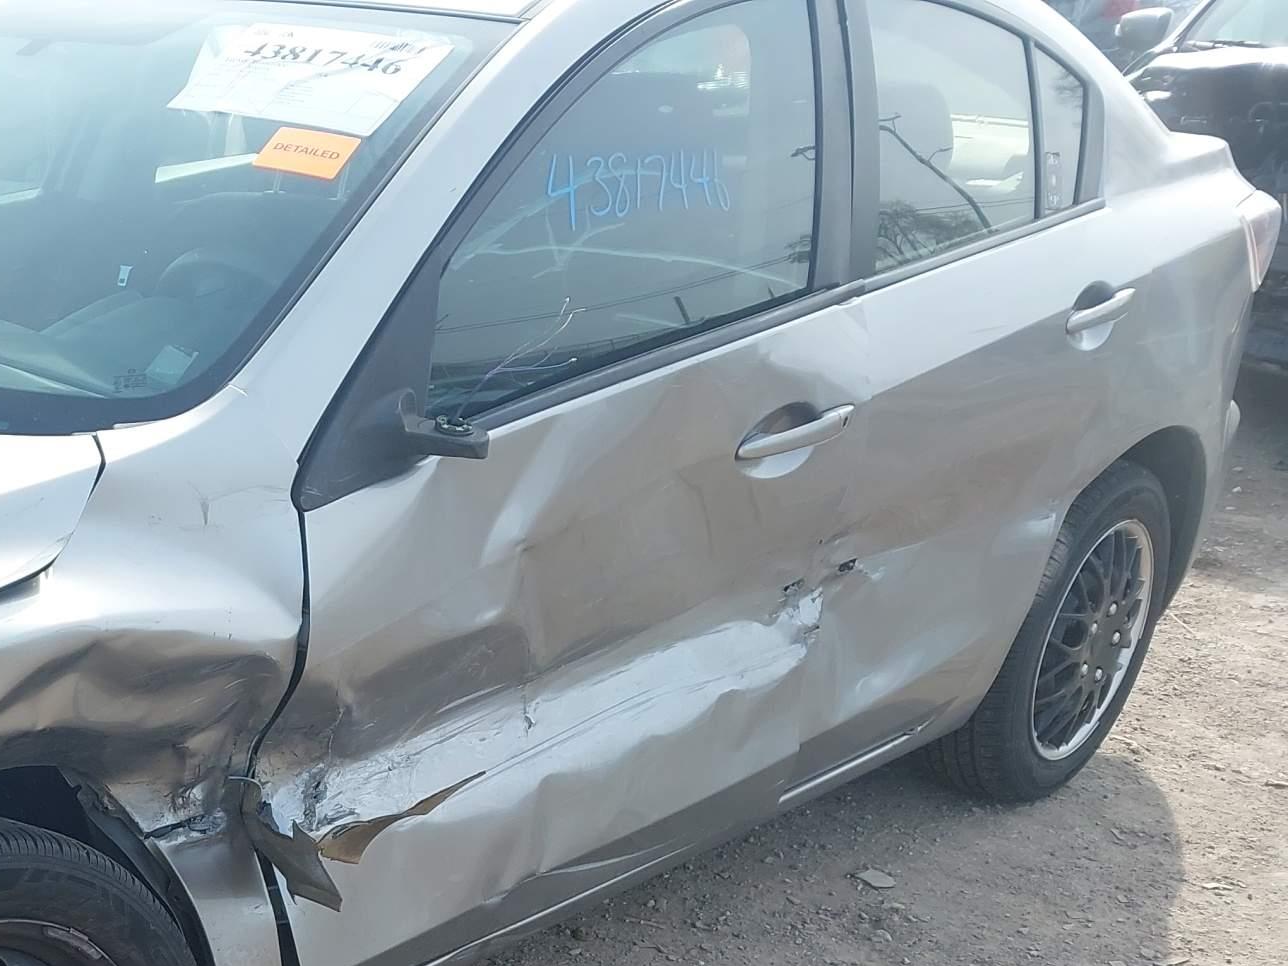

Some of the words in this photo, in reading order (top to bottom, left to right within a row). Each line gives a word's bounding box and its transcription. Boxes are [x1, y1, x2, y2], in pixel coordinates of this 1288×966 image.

[243, 42, 403, 75] 43817446
[272, 142, 340, 161] DETAILED
[546, 148, 731, 230] 43817446
